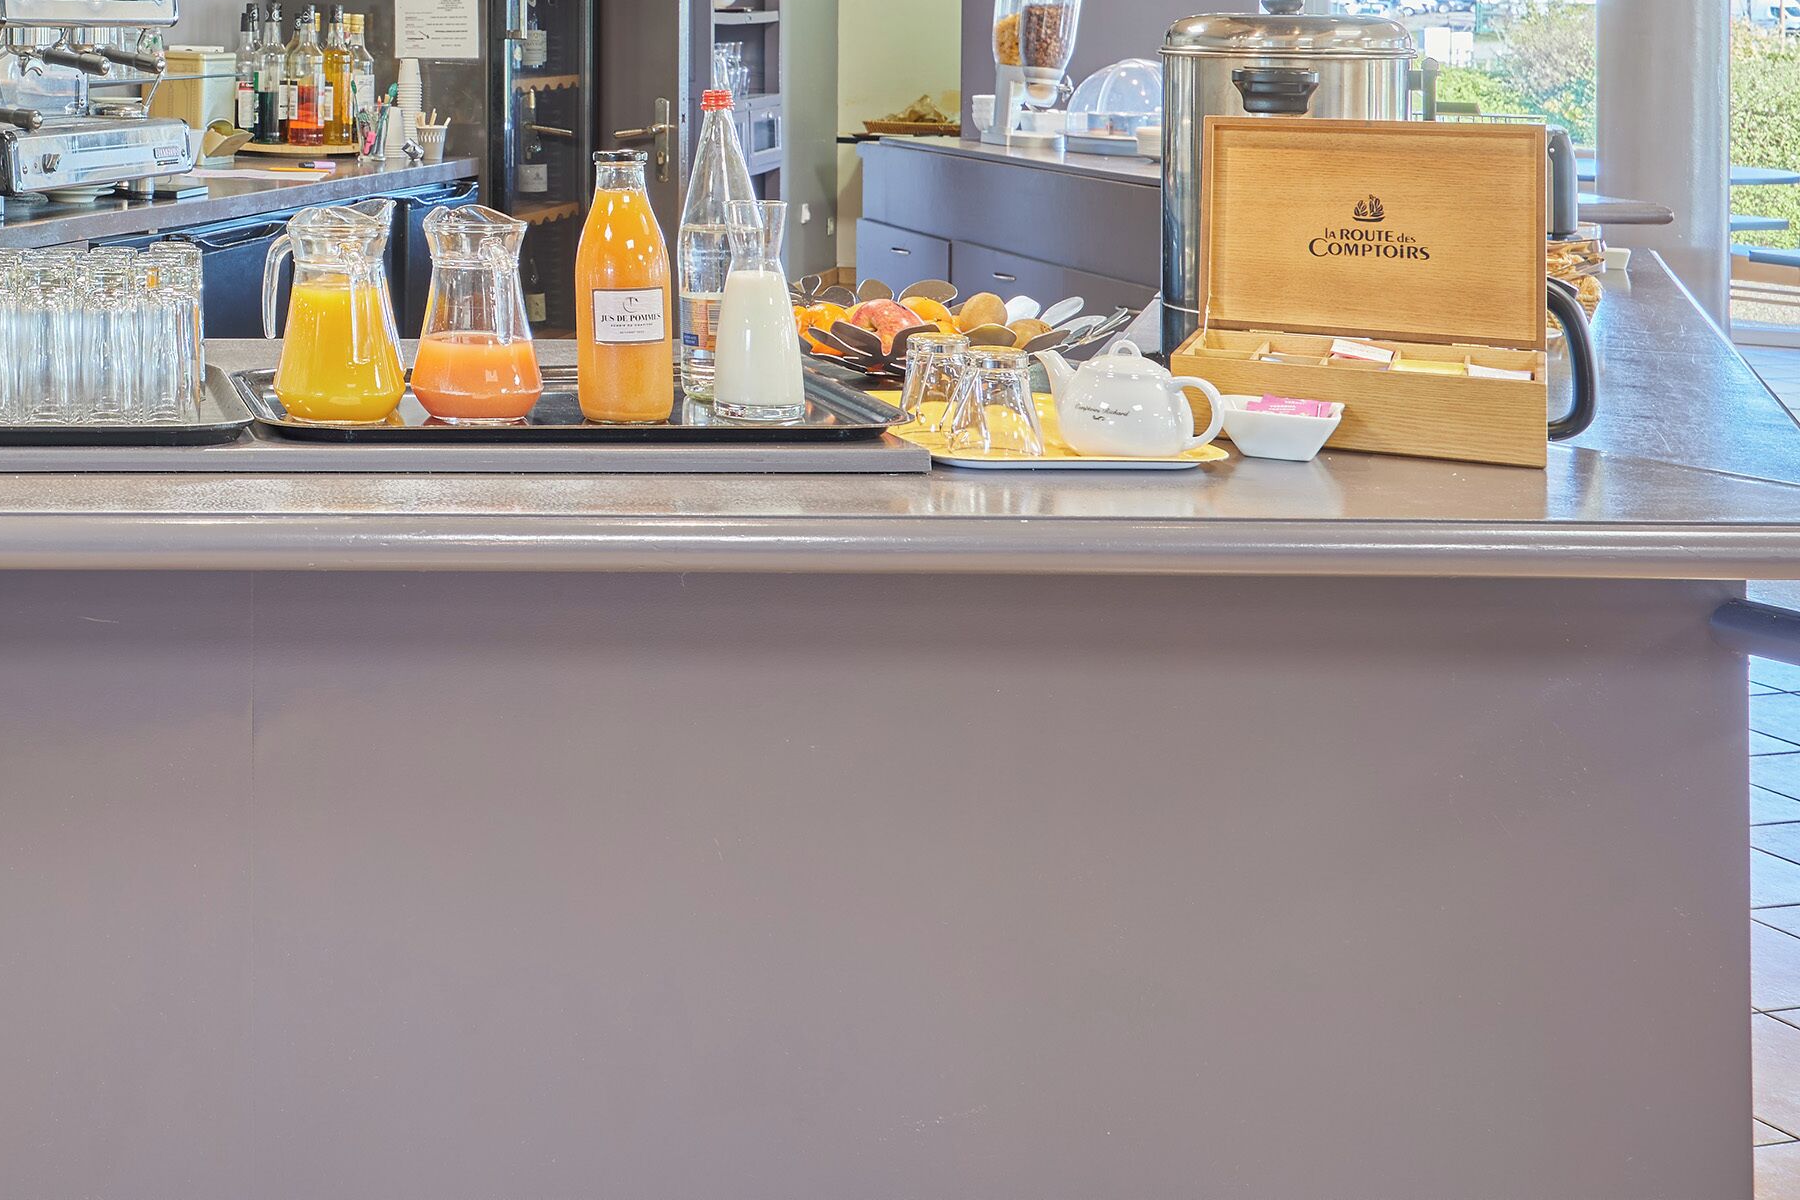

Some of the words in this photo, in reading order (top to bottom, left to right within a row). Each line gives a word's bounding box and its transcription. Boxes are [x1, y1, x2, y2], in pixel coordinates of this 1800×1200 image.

[1340, 228, 1394, 242] ROUTE
[601, 314, 615, 323] JUS
[617, 314, 628, 322] DE
[630, 313, 661, 322] POMMES
